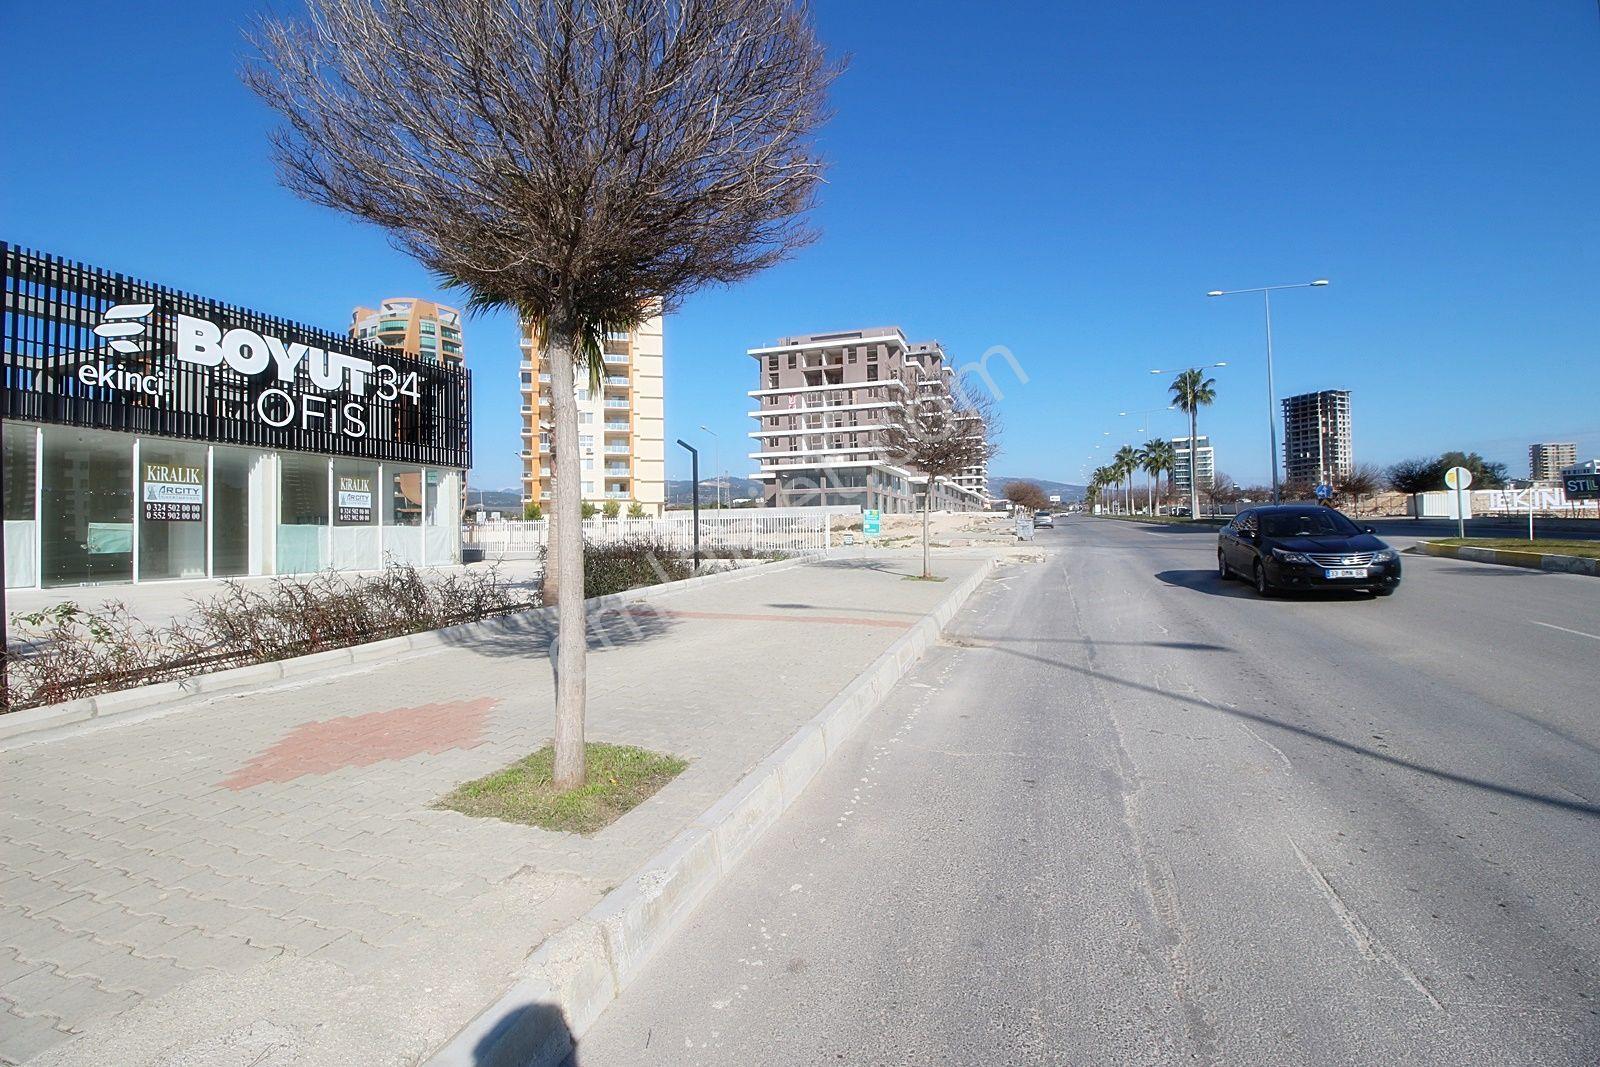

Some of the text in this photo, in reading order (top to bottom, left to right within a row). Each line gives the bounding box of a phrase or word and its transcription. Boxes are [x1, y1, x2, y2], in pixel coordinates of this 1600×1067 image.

[177, 313, 421, 405] BOYUT 34
[78, 361, 165, 396] ekinci
[159, 485, 200, 494] ARCITY
[146, 503, 151, 511] 0
[152, 503, 166, 512] 324
[167, 504, 180, 512] 502
[181, 504, 191, 512] 00
[152, 512, 166, 520] 552
[167, 512, 180, 520] 902
[181, 512, 191, 520] 00
